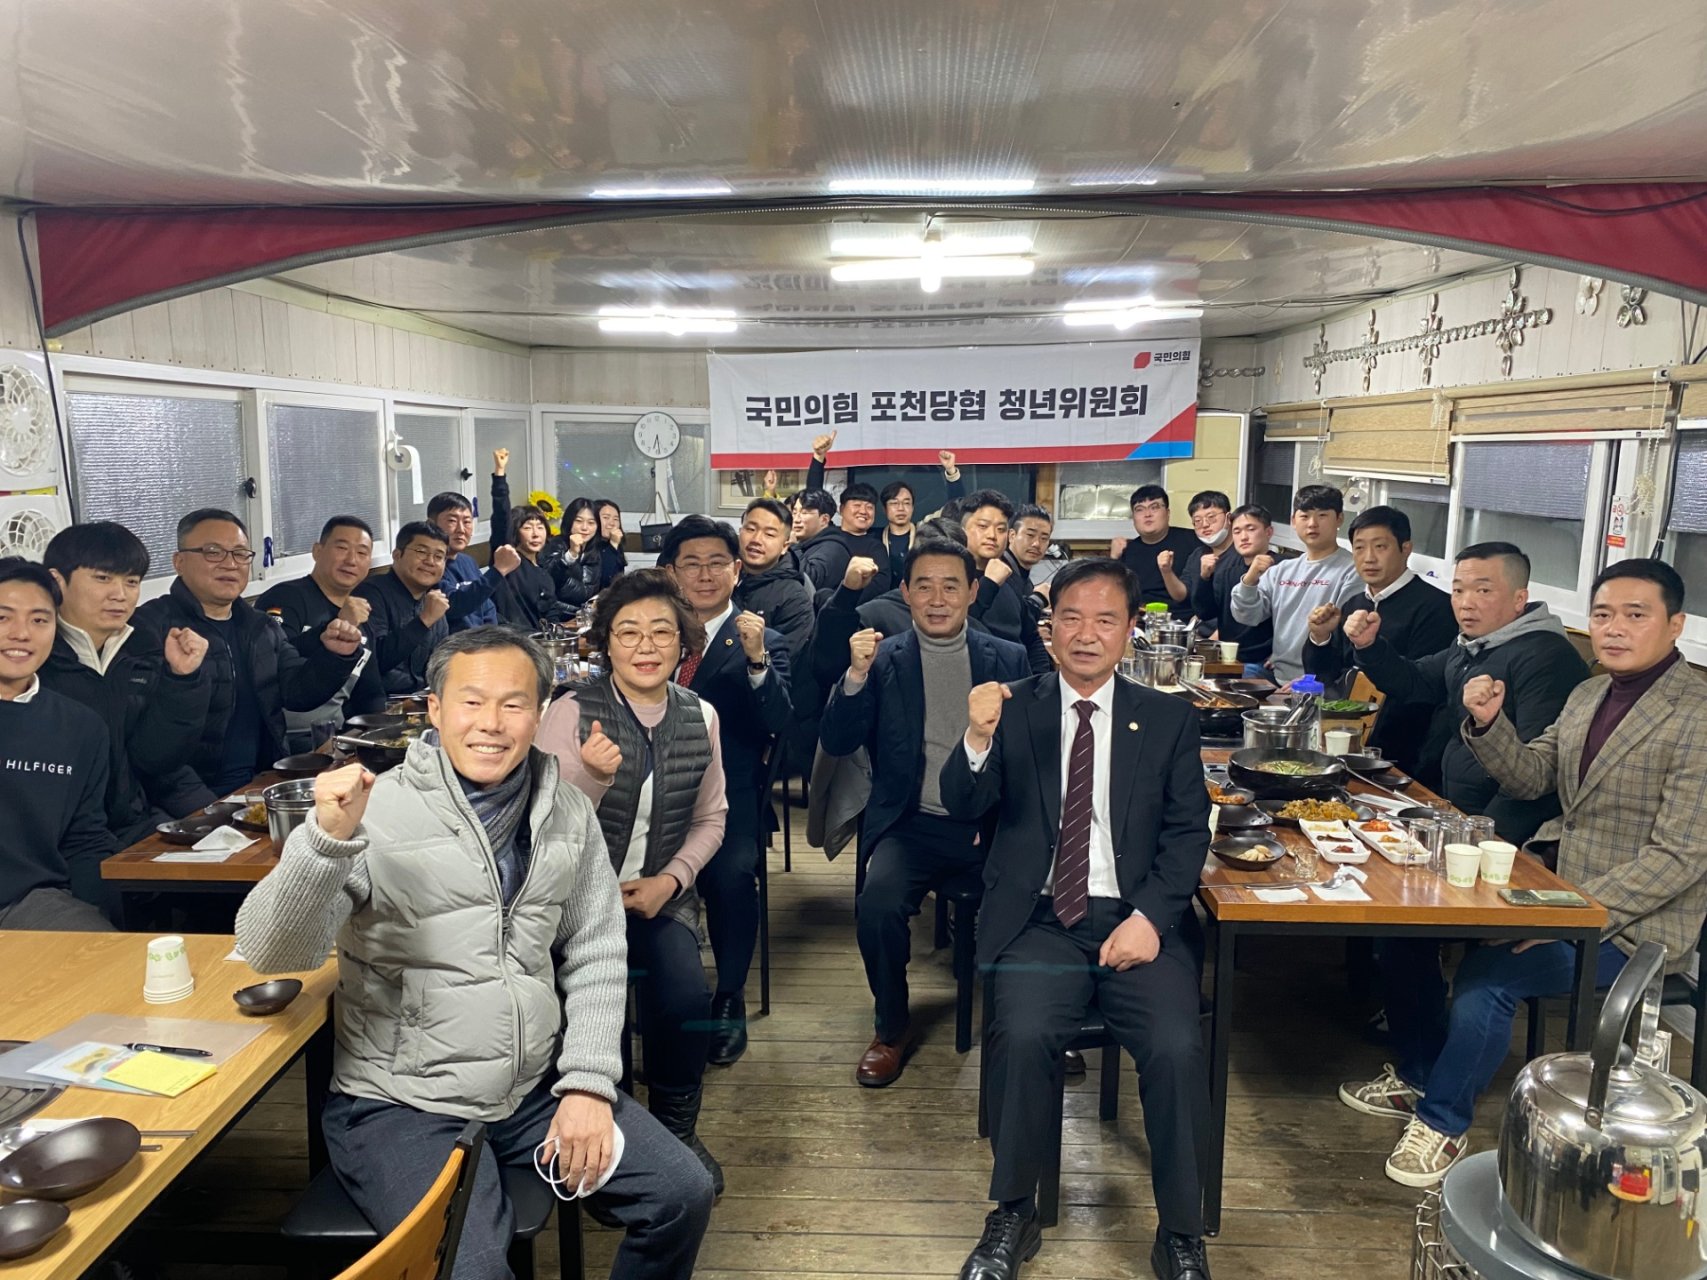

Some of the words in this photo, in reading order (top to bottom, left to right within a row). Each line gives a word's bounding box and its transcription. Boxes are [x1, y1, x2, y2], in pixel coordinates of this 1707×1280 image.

[1153, 350, 1191, 362] 국민의힘
[745, 392, 859, 427] 국민의힘
[870, 390, 986, 422] 포천당협
[998, 384, 1149, 421] 청년위원회
[6, 759, 73, 775] HILFIGER
